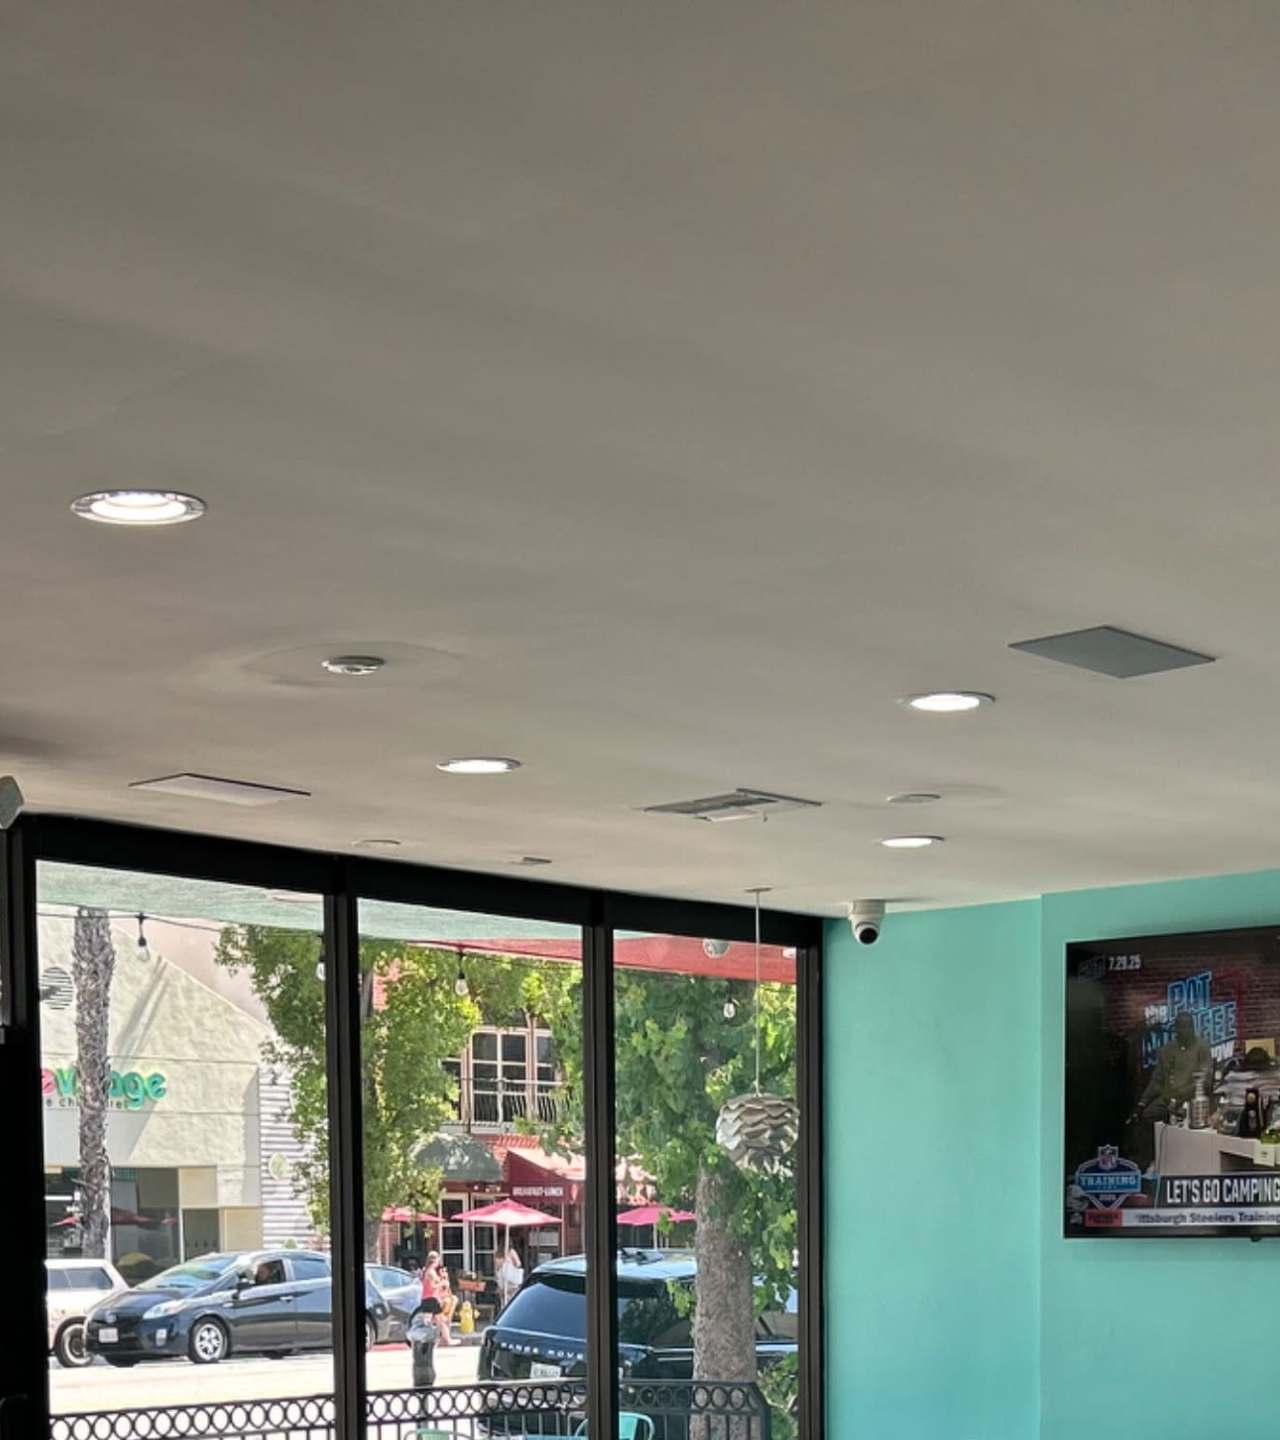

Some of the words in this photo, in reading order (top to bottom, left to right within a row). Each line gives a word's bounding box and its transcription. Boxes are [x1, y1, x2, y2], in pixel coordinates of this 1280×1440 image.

[1080, 1175, 1137, 1187] TRAINING
[1166, 1179, 1201, 1204] LET'S
[1203, 1179, 1220, 1203] GO
[1190, 1210, 1236, 1223] Steelers
[547, 1349, 585, 1361] ROVE
